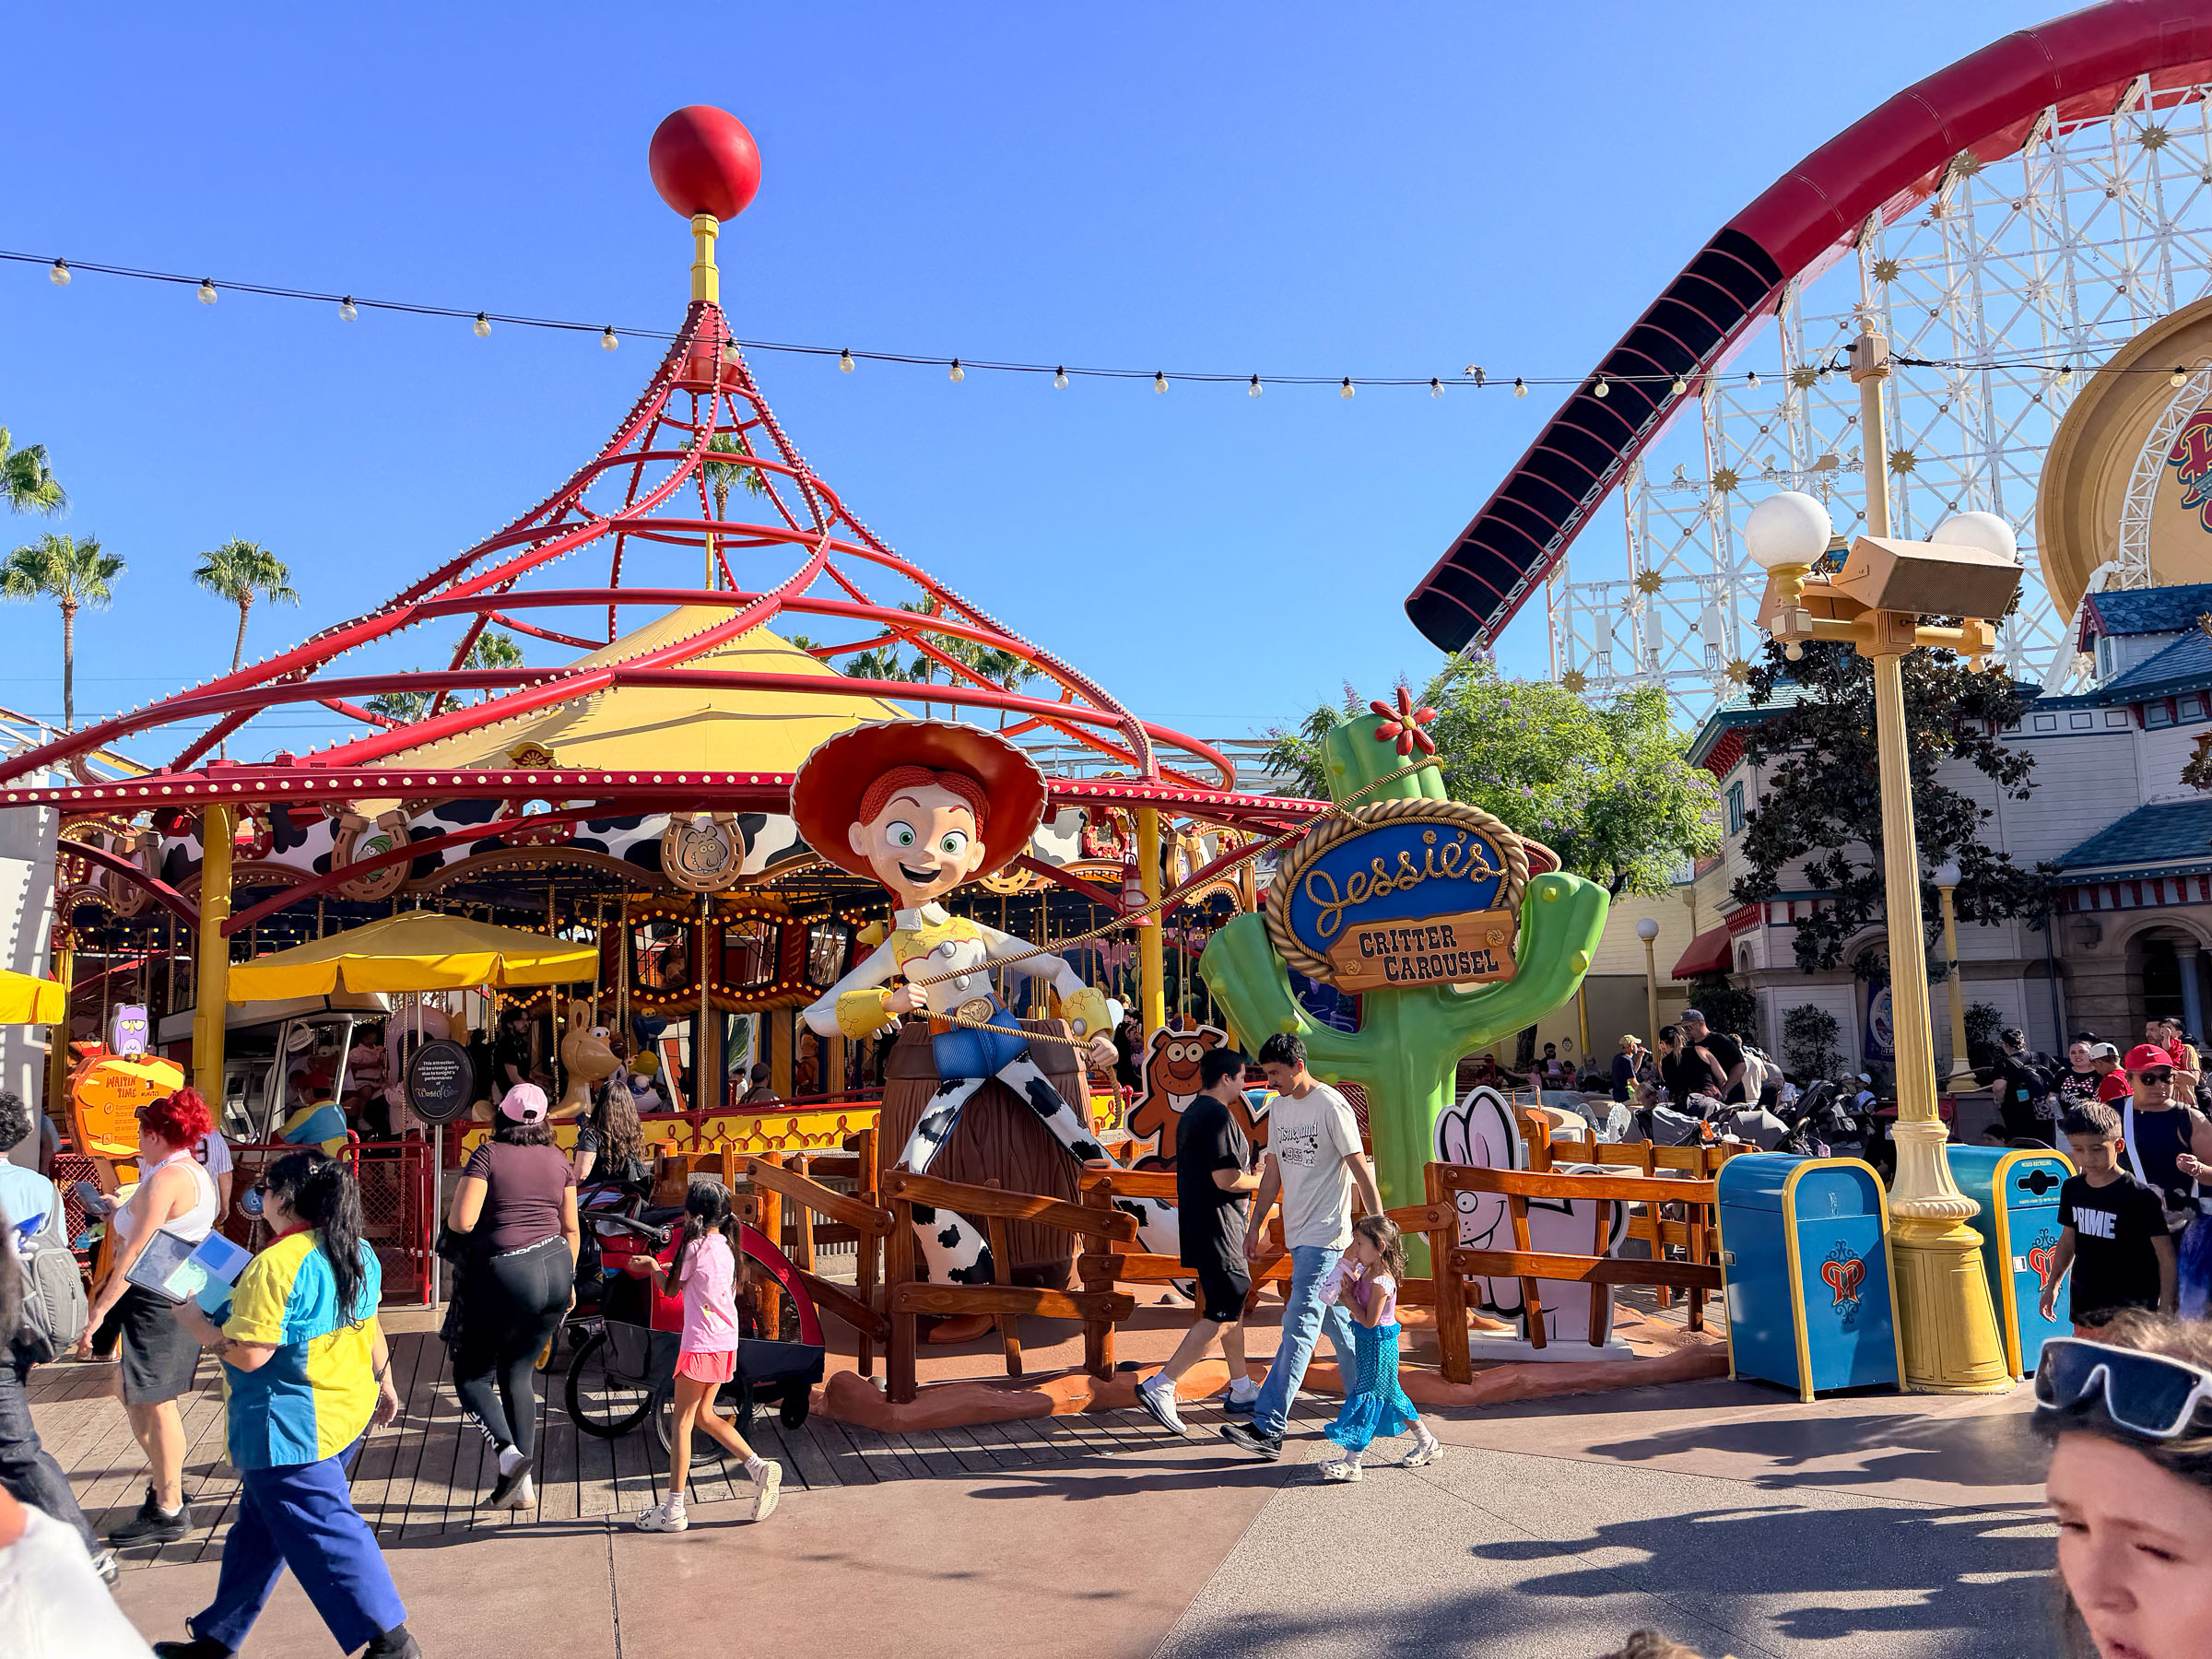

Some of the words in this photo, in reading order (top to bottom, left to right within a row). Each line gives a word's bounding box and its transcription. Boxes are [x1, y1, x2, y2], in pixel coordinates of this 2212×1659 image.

[1306, 830, 1509, 937] Jessie's
[1359, 924, 1458, 959] CRITTER
[1382, 948, 1500, 982] CAROUSEL
[106, 1074, 138, 1088] WAITIN'
[117, 1088, 137, 1098] TIME
[416, 1088, 436, 1098] World
[2072, 1206, 2117, 1240] PRIME
[467, 1411, 500, 1450] NIKE
